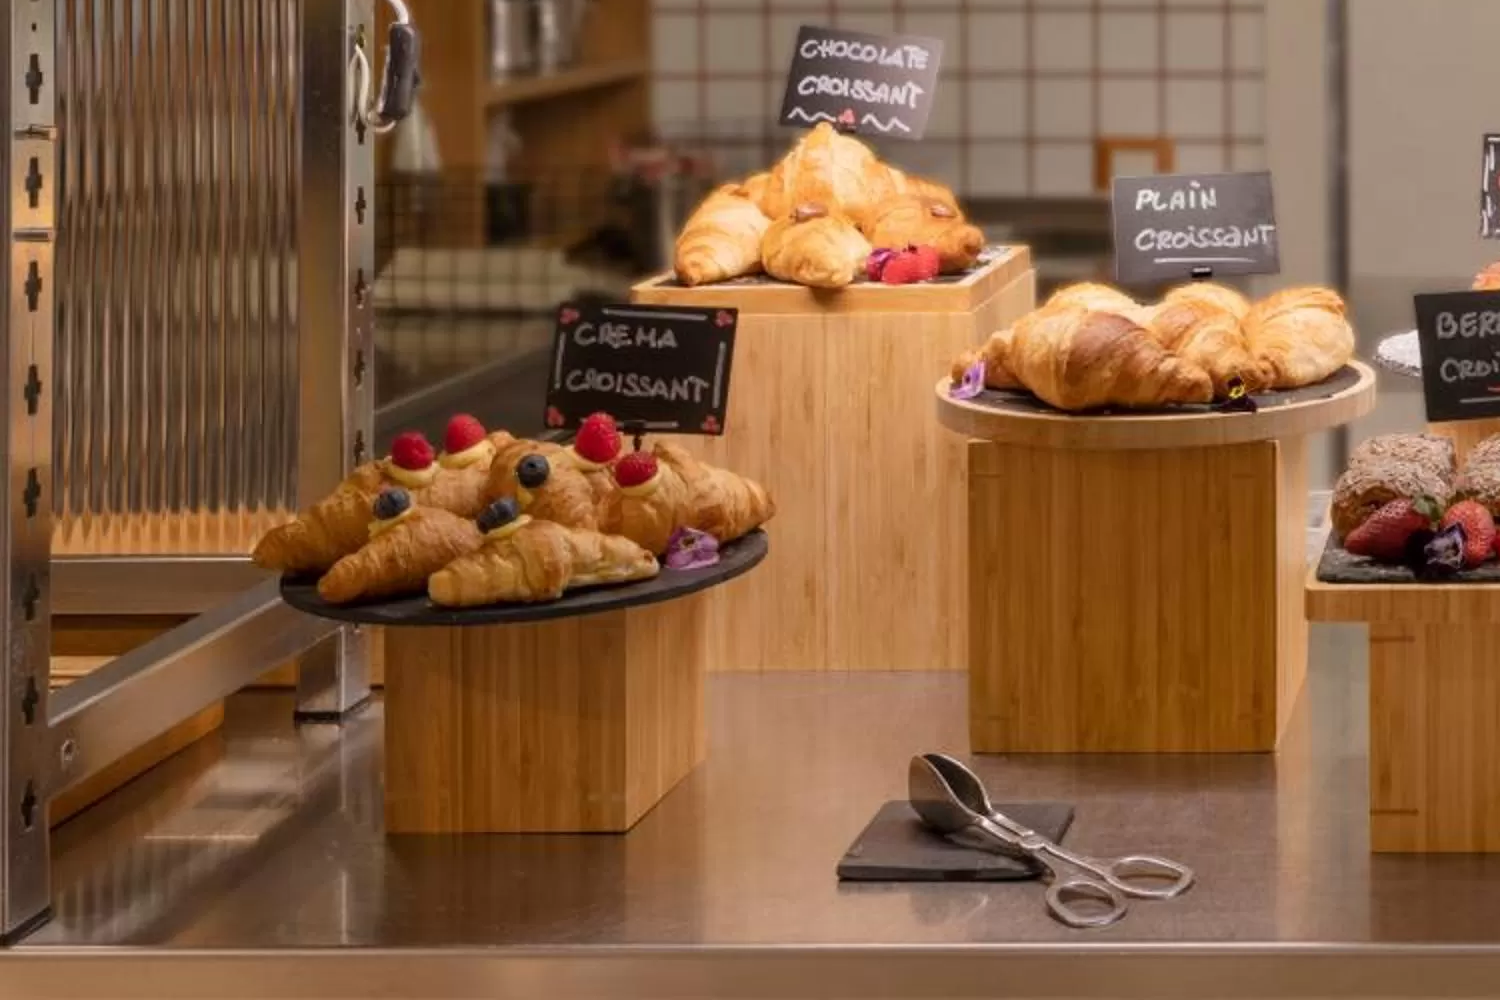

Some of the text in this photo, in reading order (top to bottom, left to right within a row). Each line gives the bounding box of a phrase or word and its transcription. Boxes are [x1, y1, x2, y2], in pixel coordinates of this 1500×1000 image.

[800, 39, 929, 70] CHOCOLATE
[798, 75, 926, 109] CROISSANT
[573, 321, 679, 350] CREMA
[565, 367, 711, 404] CROISSANT
